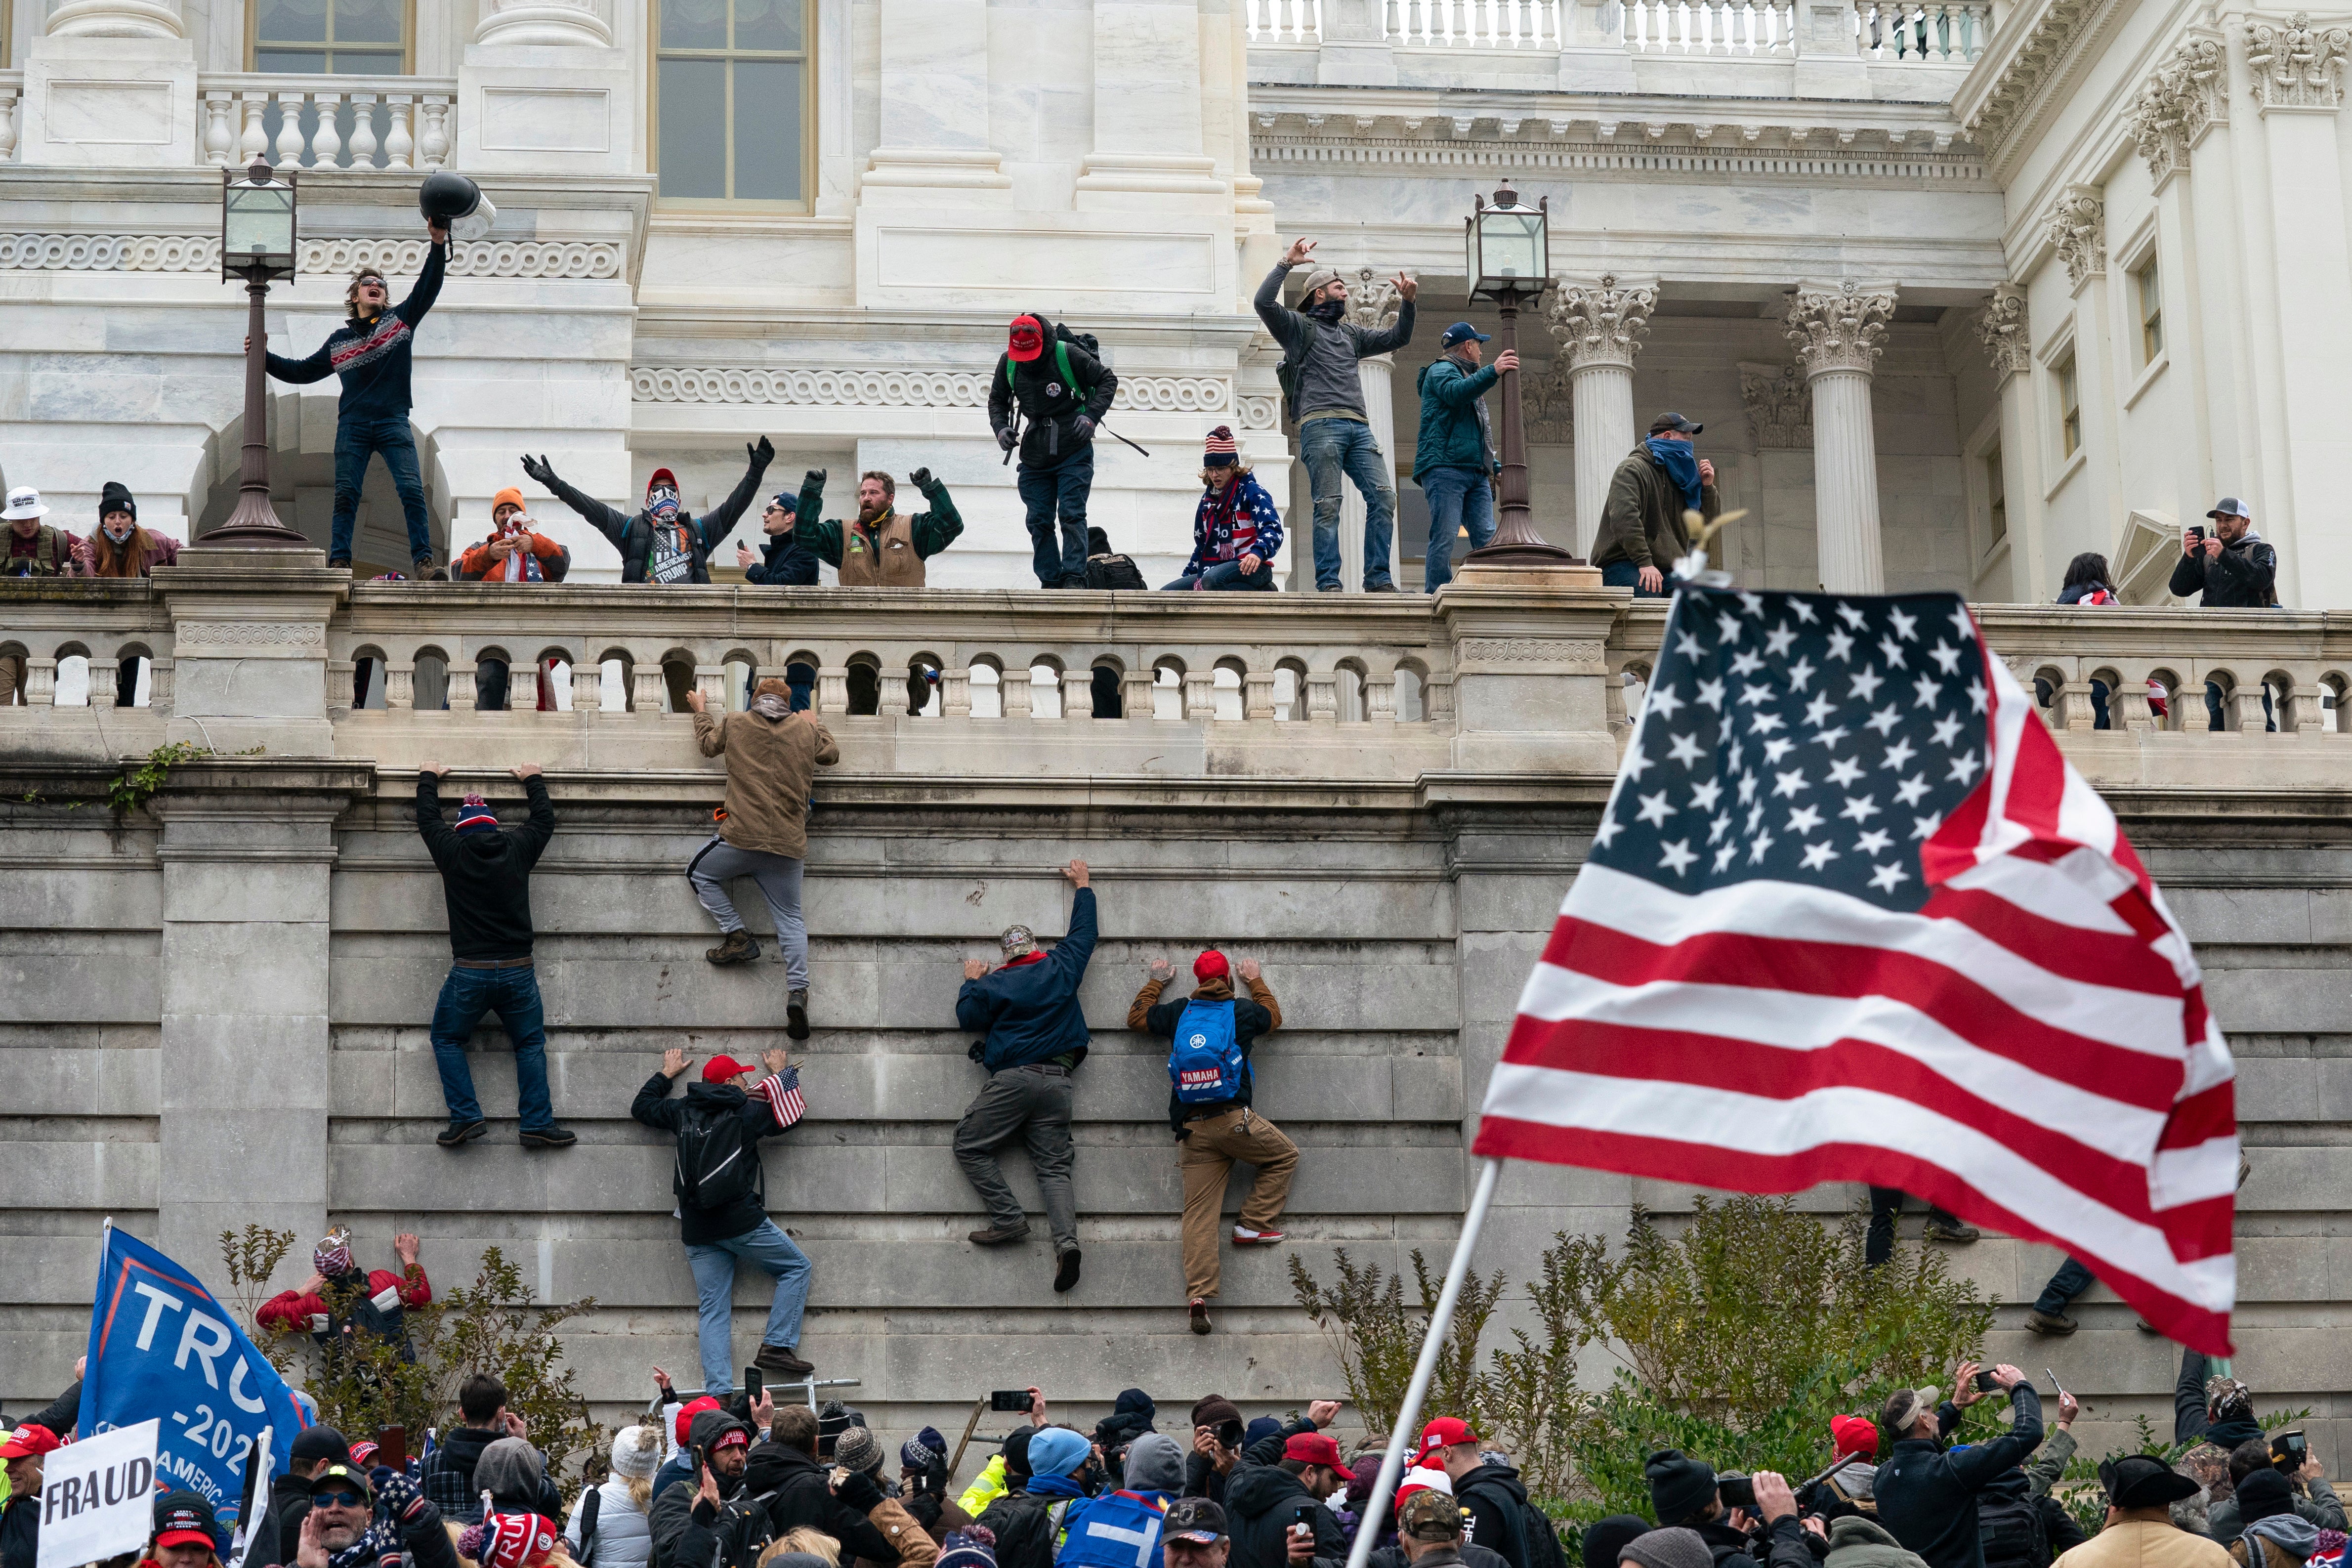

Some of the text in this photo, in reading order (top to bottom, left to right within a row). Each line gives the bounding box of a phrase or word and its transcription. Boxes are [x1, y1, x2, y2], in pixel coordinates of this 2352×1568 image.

[654, 552, 690, 573] AMERICANS
[655, 562, 688, 584] TRUMP
[1181, 1069, 1219, 1083] YAMAHA
[134, 1281, 266, 1414] TRU
[45, 1457, 152, 1526] FRAUD
[156, 1450, 223, 1507] AMERIC
[492, 1514, 526, 1568] TRUM
[540, 1536, 549, 1548] 45
